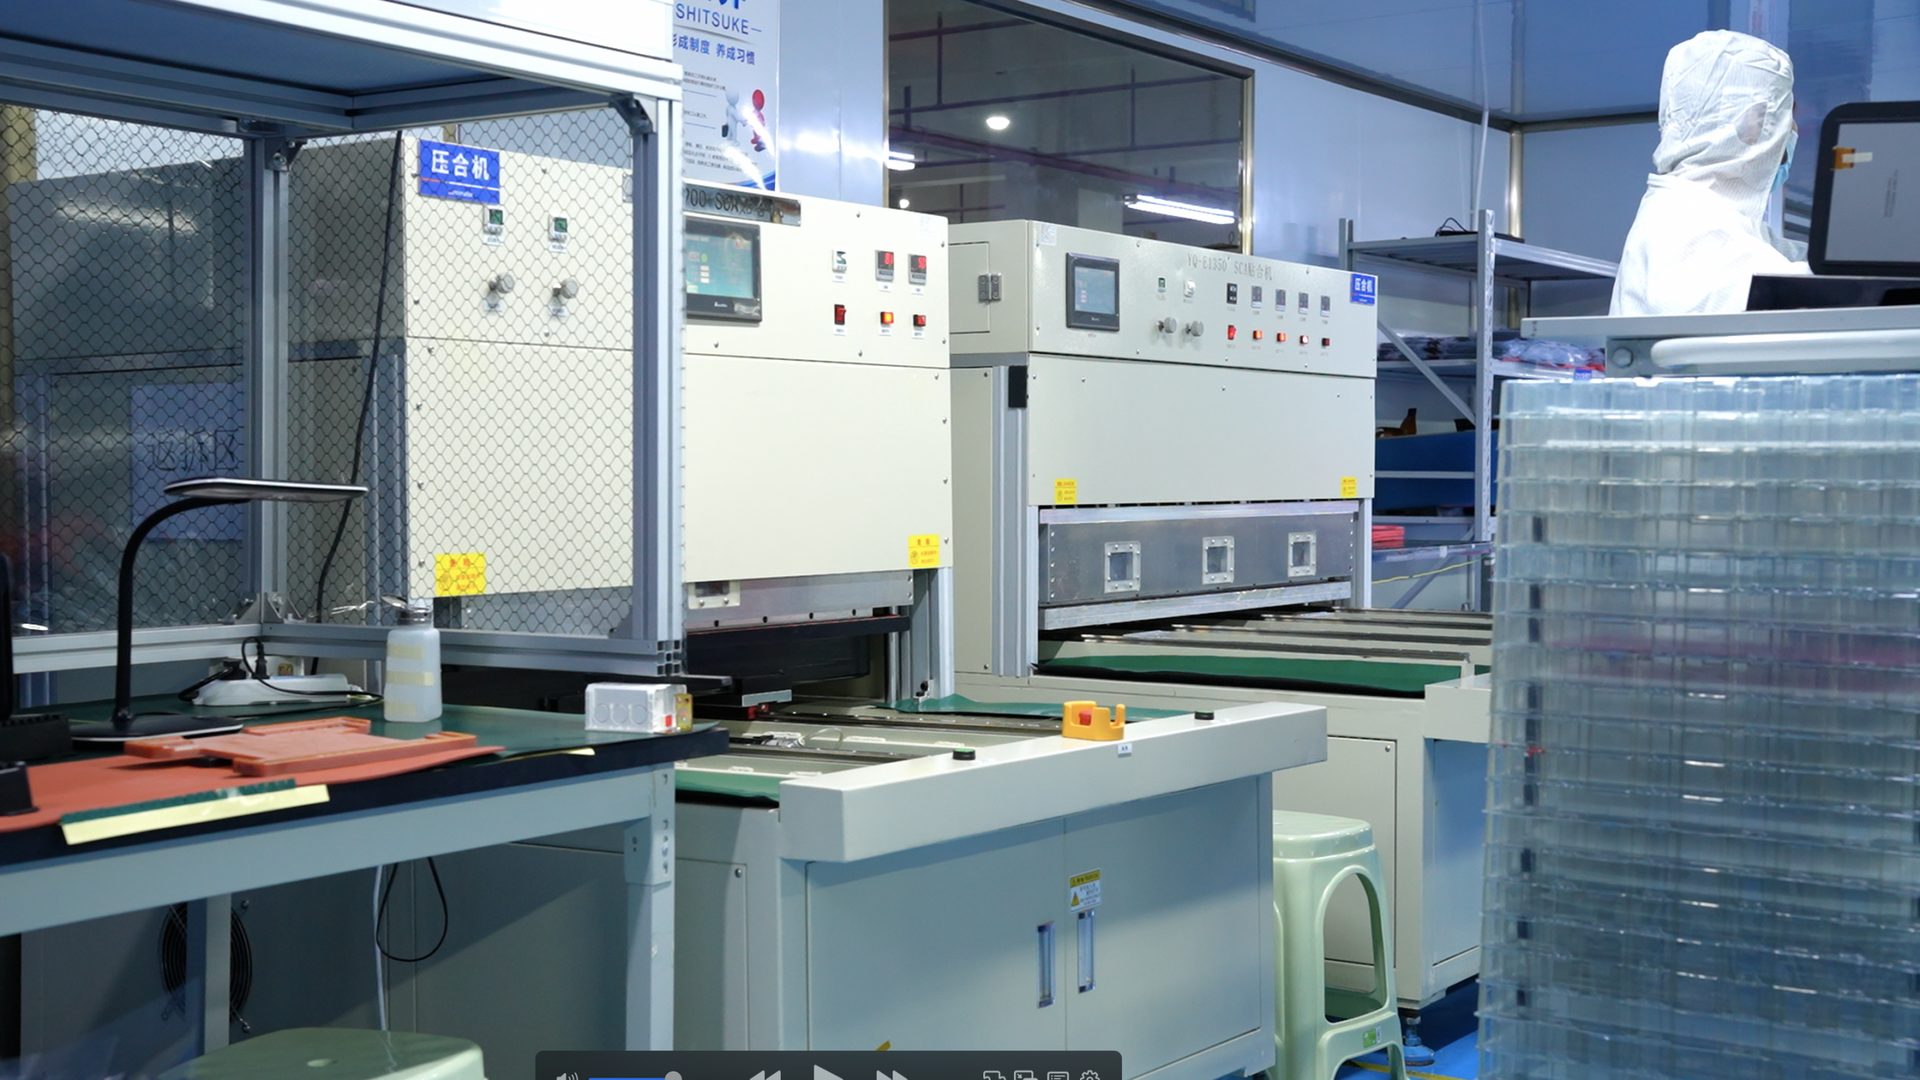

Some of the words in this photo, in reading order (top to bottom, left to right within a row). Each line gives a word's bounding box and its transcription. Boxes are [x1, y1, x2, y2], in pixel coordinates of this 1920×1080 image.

[676, 3, 749, 35] SHITSUKE
[717, 43, 755, 65] 养成习惯
[431, 149, 490, 181] 压合机
